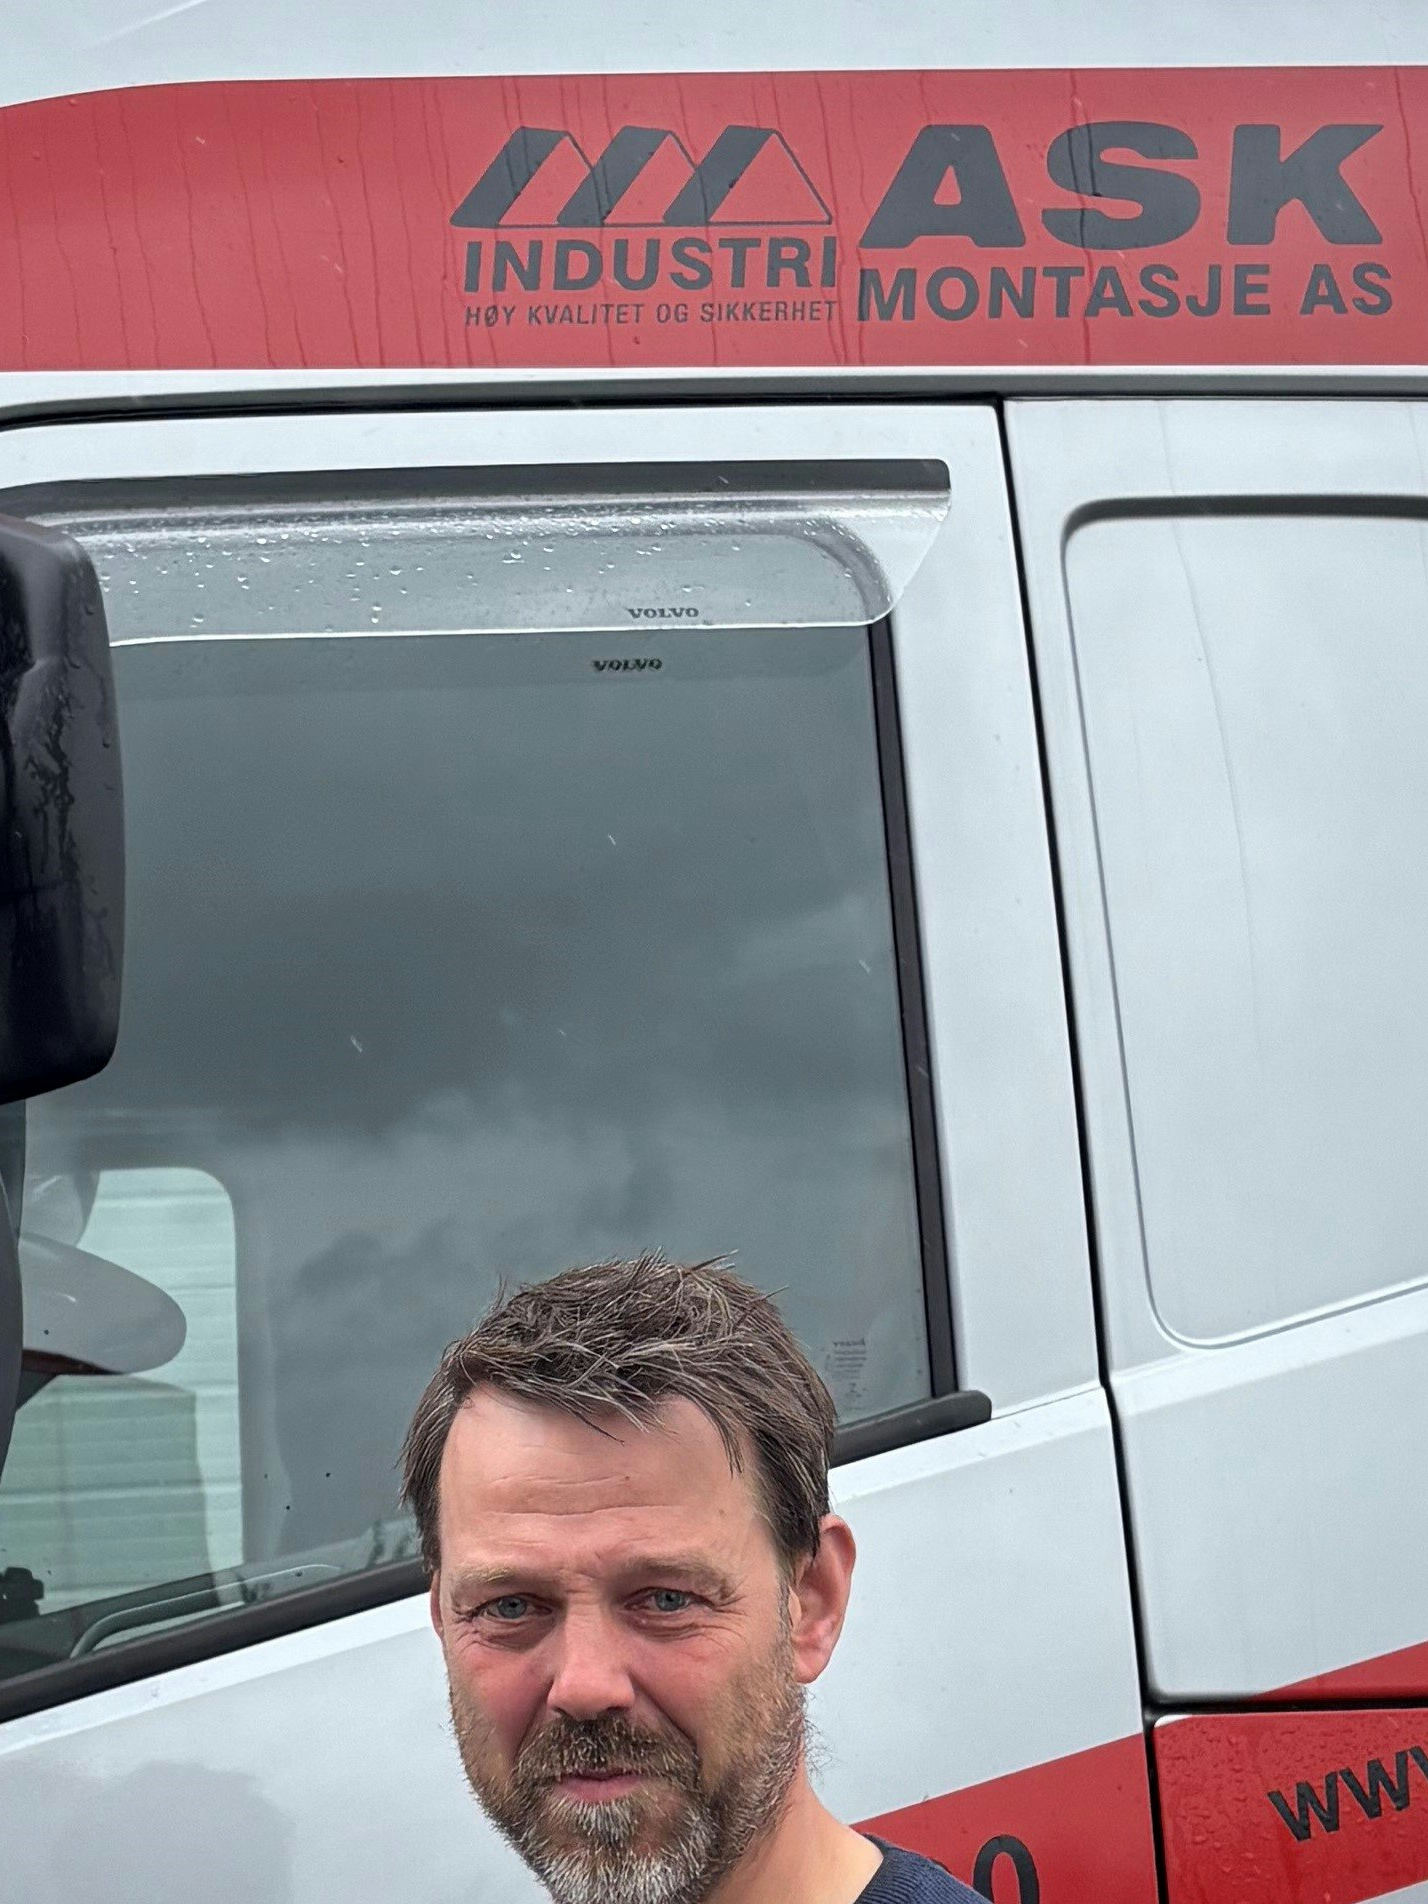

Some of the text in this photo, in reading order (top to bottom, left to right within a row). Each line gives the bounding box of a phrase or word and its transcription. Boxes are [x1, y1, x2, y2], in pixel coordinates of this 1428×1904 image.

[857, 120, 1385, 251] ASK
[463, 236, 838, 293] INDUSTRI
[857, 262, 1394, 322] MONTASJE AS
[464, 299, 838, 328] HØY KVALITET OG SIKKERHET
[626, 607, 700, 620] VOLVO
